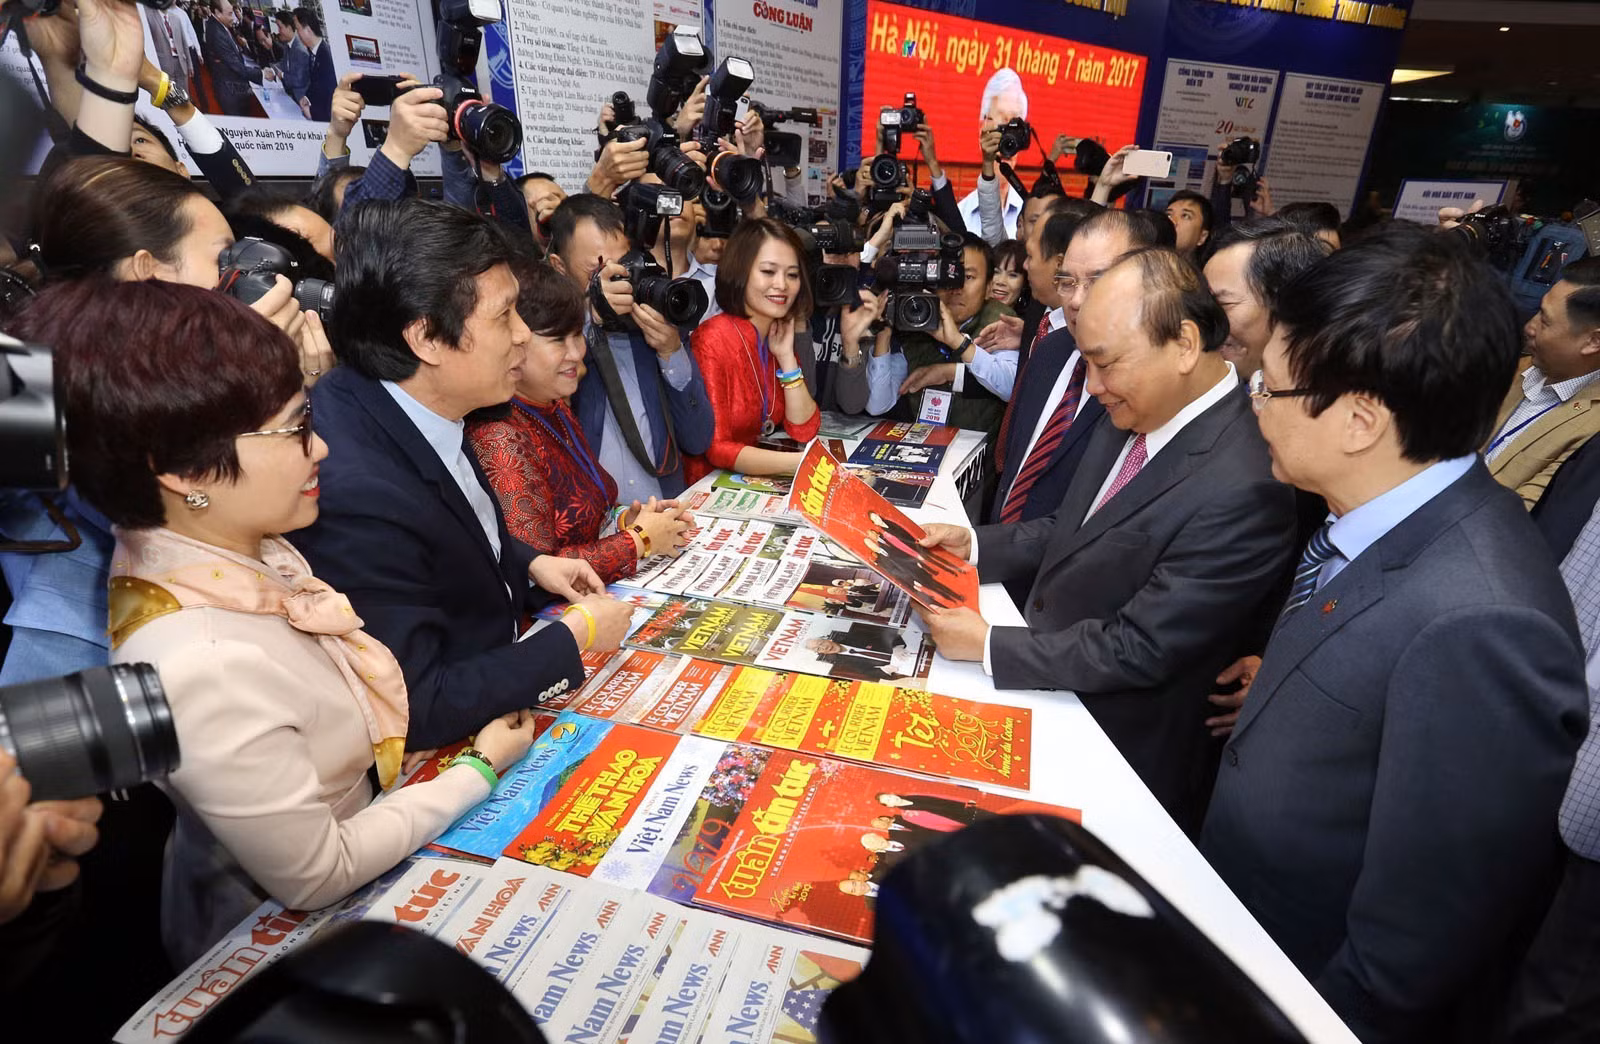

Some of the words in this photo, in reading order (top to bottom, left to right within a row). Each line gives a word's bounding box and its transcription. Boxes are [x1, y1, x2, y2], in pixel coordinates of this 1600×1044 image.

[786, 10, 813, 34] LUẬN
[870, 12, 898, 55] Hà
[905, 18, 940, 69] Nội,
[946, 29, 990, 76] ngày
[993, 36, 1010, 70] 31
[1016, 38, 1060, 84] tháng
[1066, 48, 1076, 78] 7
[1075, 53, 1105, 83] năm
[1107, 58, 1140, 88] 2017
[255, 129, 274, 138] Xuân
[277, 130, 296, 139] Phúc
[308, 132, 322, 140] khai
[256, 142, 273, 150] năm
[276, 142, 294, 151] 2019
[1216, 120, 1233, 134] 20
[718, 556, 732, 571] LAW
[781, 561, 798, 578] LAW
[680, 606, 733, 650] VIETNAM
[722, 612, 768, 657] VIETNAM
[763, 619, 806, 661] VIETNAM
[580, 704, 594, 713] LE
[591, 670, 630, 708] COURRIER
[596, 671, 644, 715] VIETNAM
[654, 680, 689, 719] COURRIER
[660, 682, 704, 726] VIETNAM
[712, 689, 742, 727] COURRIER
[720, 691, 758, 734] VIETNAM
[772, 696, 800, 736] COURRIER
[781, 697, 815, 742] VIETNAM
[843, 704, 868, 746] COURRIER
[855, 705, 882, 751] VIETNAM
[767, 734, 780, 742] LE
[1000, 742, 1012, 753] du
[459, 804, 500, 832] Việt
[493, 778, 529, 806] Nam
[517, 748, 558, 778] News
[587, 750, 638, 796] THAO
[626, 827, 664, 853] Việt
[645, 796, 680, 826] Nam
[664, 764, 699, 795] News
[394, 869, 461, 923] tức
[538, 883, 562, 912] ANN
[597, 900, 619, 929] ANN
[484, 914, 539, 963] News
[647, 912, 666, 939] ANN
[708, 929, 726, 958] ANN
[547, 931, 598, 984] News
[595, 944, 645, 998] News
[766, 945, 784, 974] ANN
[662, 963, 708, 1018] News
[725, 980, 768, 1038] News
